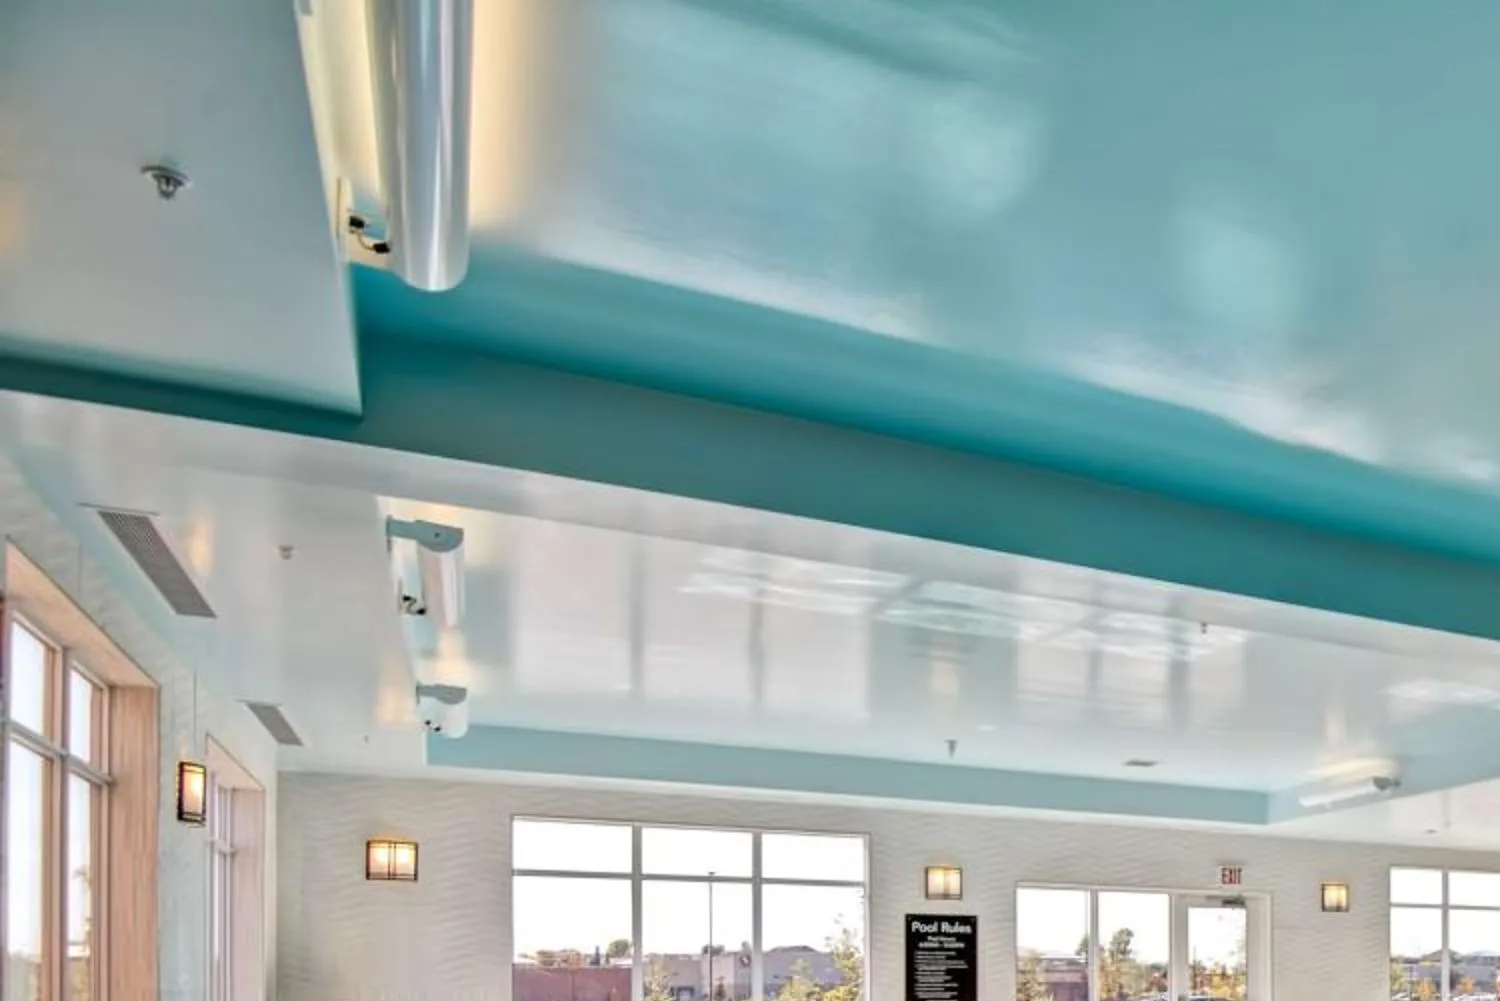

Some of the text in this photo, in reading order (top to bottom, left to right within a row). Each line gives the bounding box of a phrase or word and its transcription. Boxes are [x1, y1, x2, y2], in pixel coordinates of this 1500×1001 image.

[1221, 867, 1243, 885] EXIT
[911, 921, 973, 934] Pool Rules
